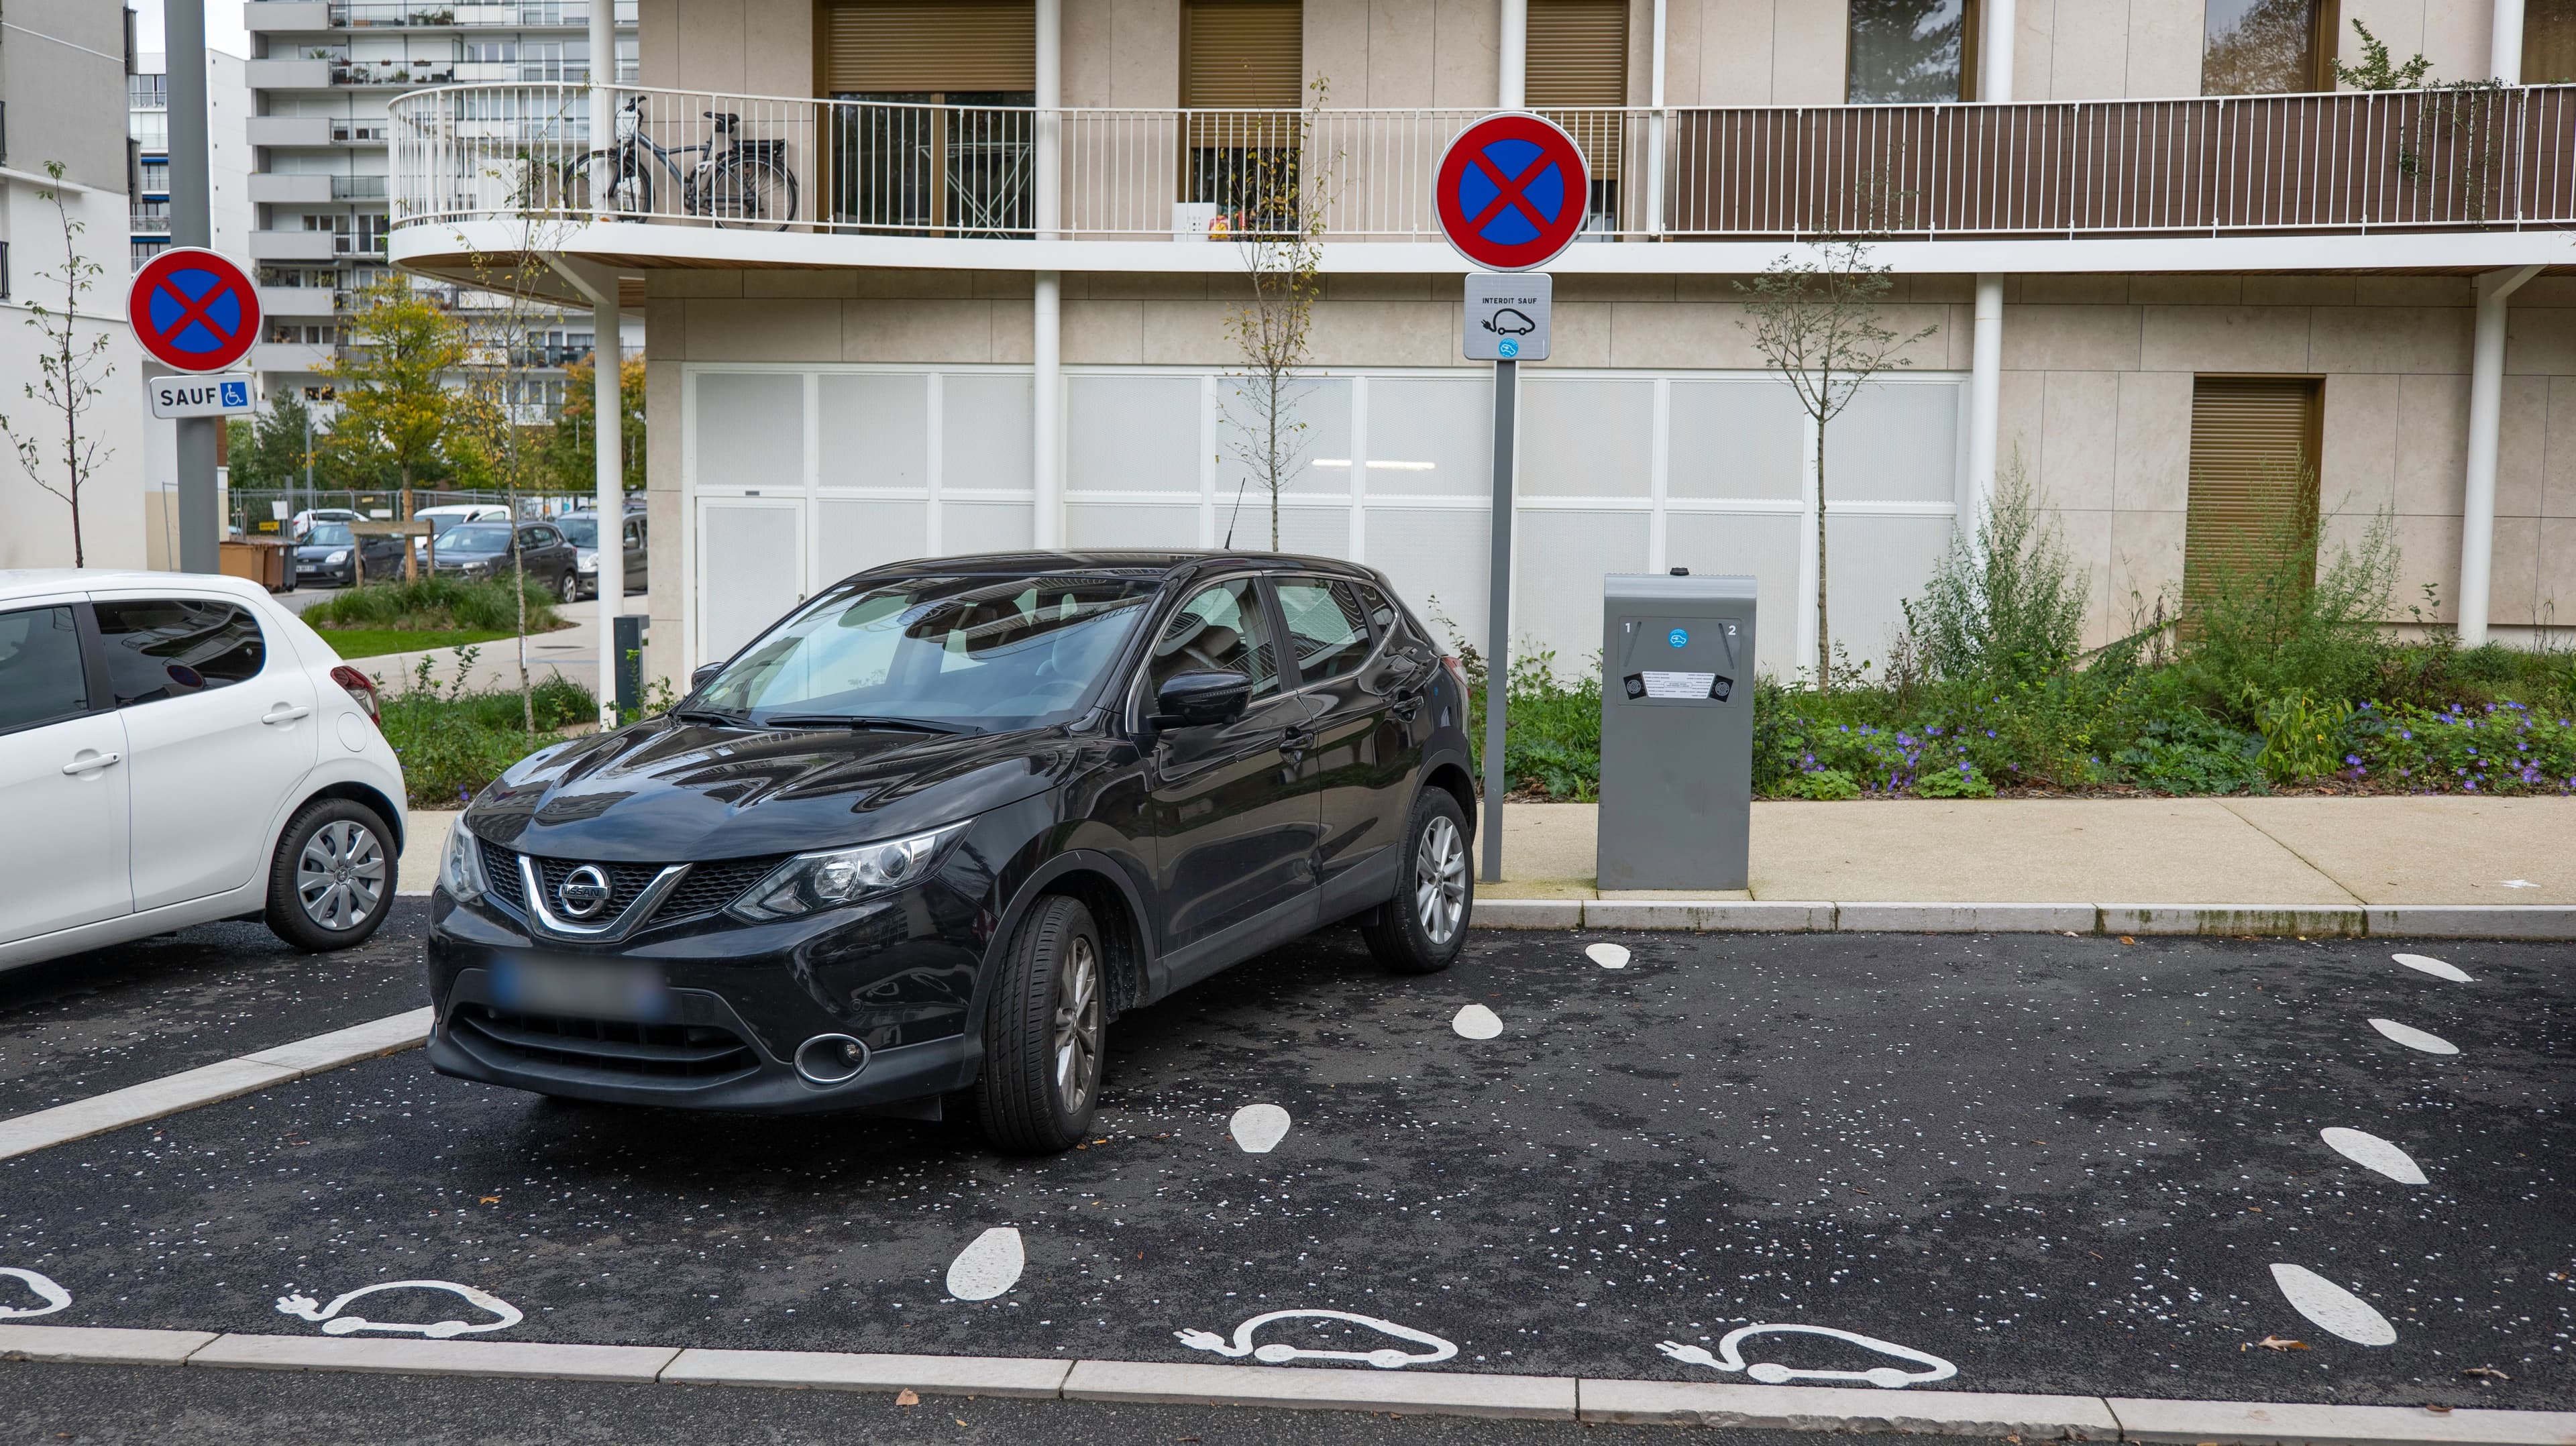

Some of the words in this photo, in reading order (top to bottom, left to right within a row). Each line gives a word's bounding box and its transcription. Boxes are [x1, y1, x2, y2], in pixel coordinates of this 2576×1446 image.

[160, 388, 216, 406] SAUF
[1625, 622, 1631, 633] 1
[1728, 625, 1736, 635] 2
[563, 886, 600, 897] NISSAN
